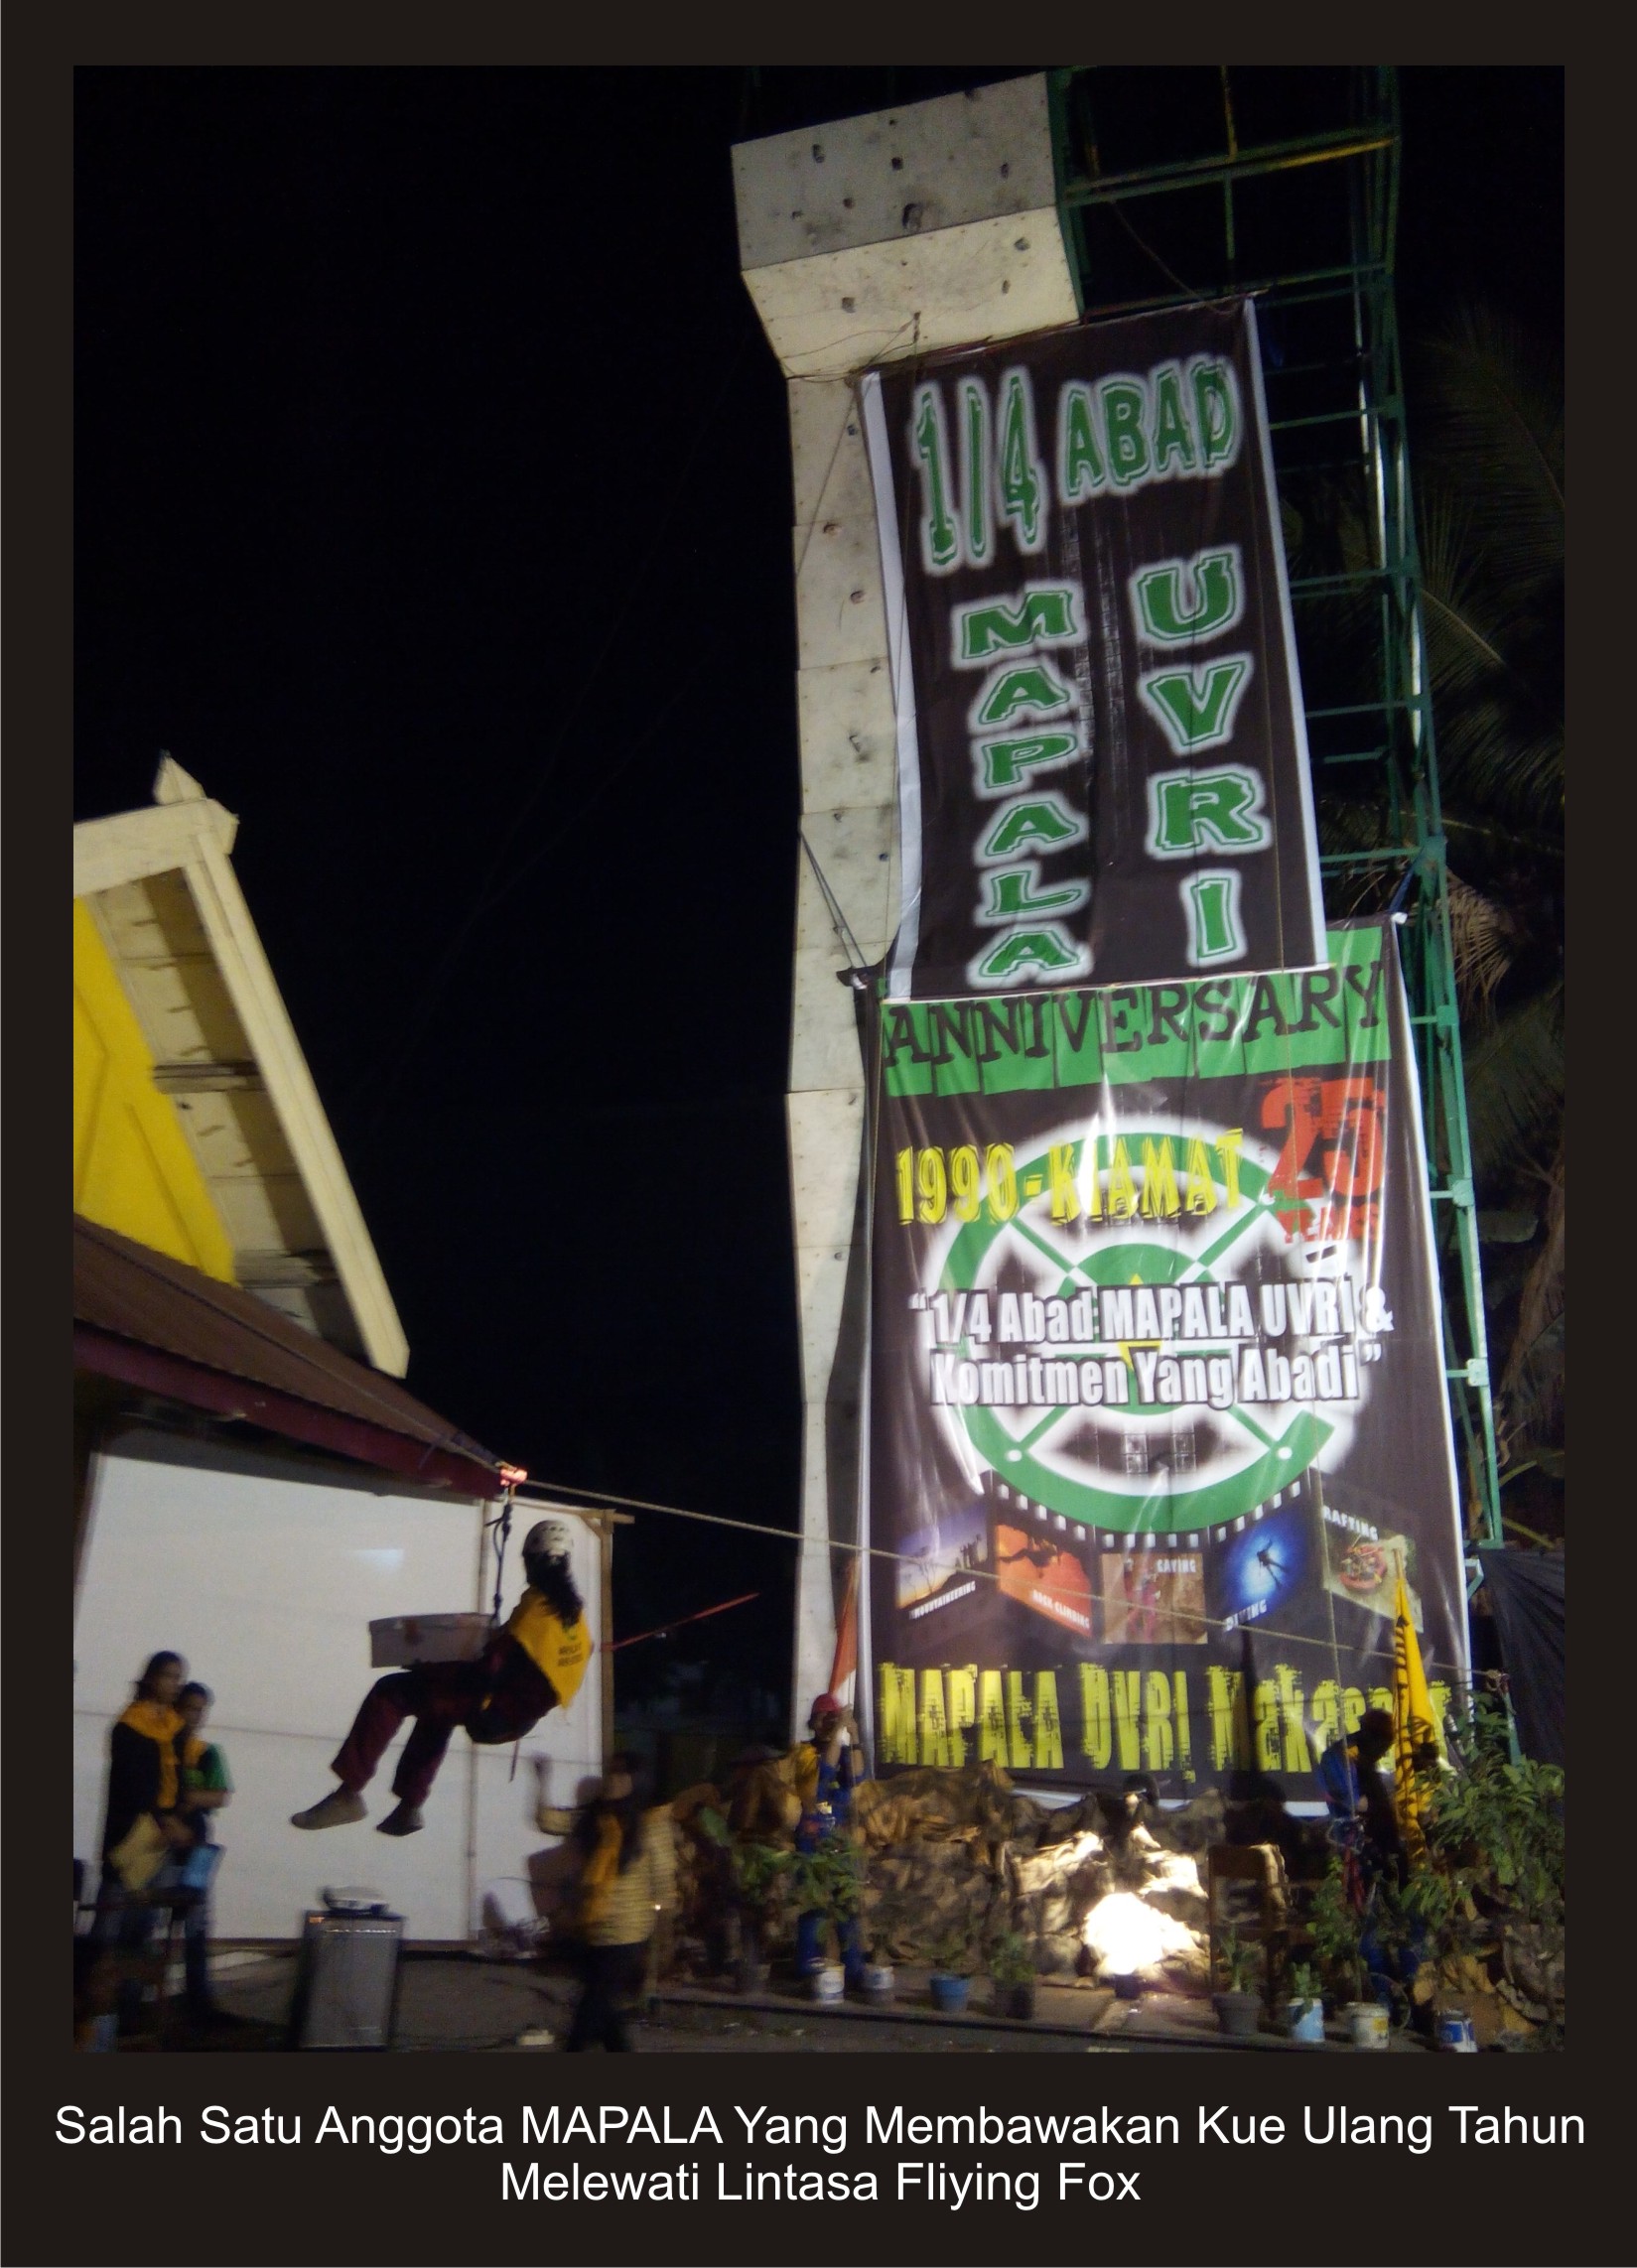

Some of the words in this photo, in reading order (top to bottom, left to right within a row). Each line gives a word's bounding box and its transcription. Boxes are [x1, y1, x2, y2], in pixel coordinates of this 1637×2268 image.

[915, 373, 1040, 567] 1/4
[1065, 359, 1239, 500] ABAD
[961, 590, 1084, 978] MAPALA
[1137, 552, 1264, 959] UVRI
[884, 961, 1387, 1068] ANNIVERSARY
[1259, 1077, 1386, 1199] 25
[997, 1288, 1094, 1344] Abad
[1100, 1286, 1256, 1342] MAPALA
[1261, 1280, 1356, 1338] UVRI
[1360, 1286, 1395, 1333] &
[931, 1351, 1130, 1405] Komitmen
[1134, 1348, 1235, 1410] Yang
[1321, 1505, 1379, 1540] RAFTING
[878, 1662, 1064, 1770] MAPALA
